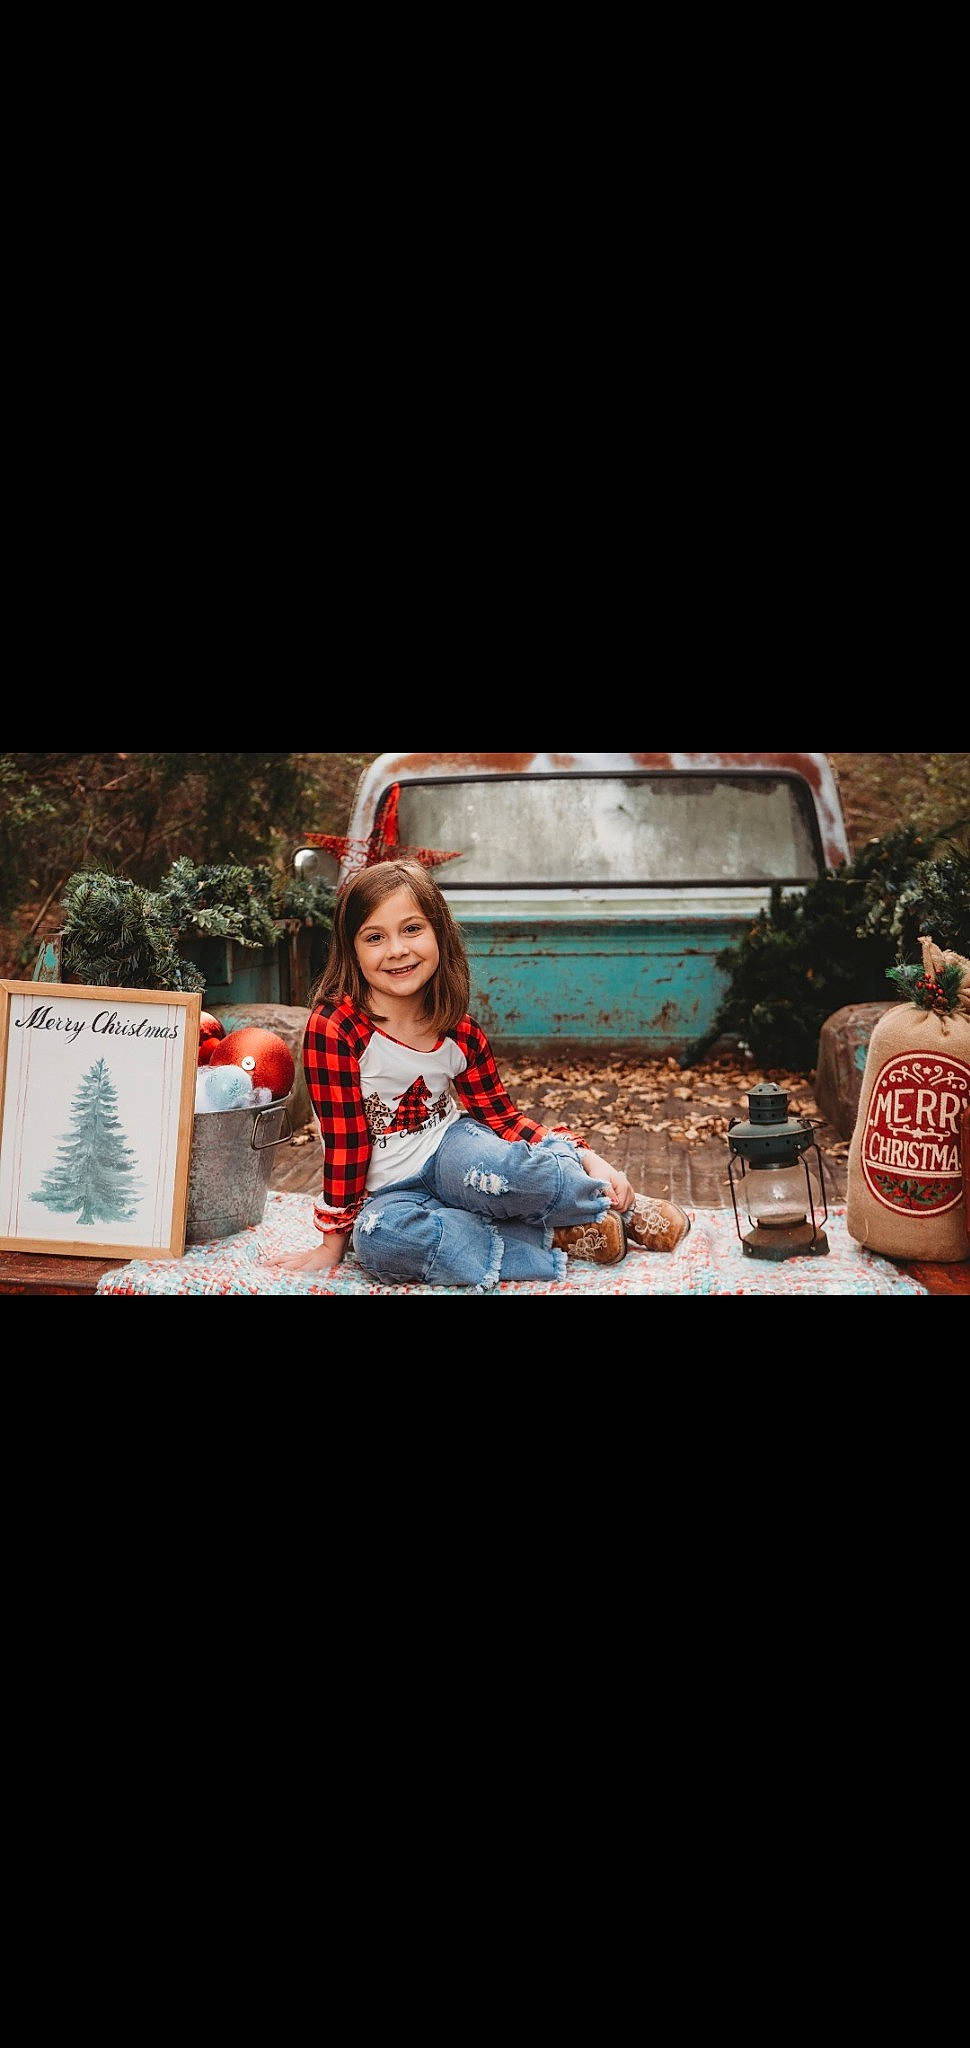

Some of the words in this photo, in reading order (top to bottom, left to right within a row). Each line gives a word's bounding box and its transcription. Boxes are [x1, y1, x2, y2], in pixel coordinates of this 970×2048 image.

[14, 1005, 87, 1044] Merry
[91, 1010, 179, 1040] Christmas
[868, 1132, 962, 1171] CHRISTMA
